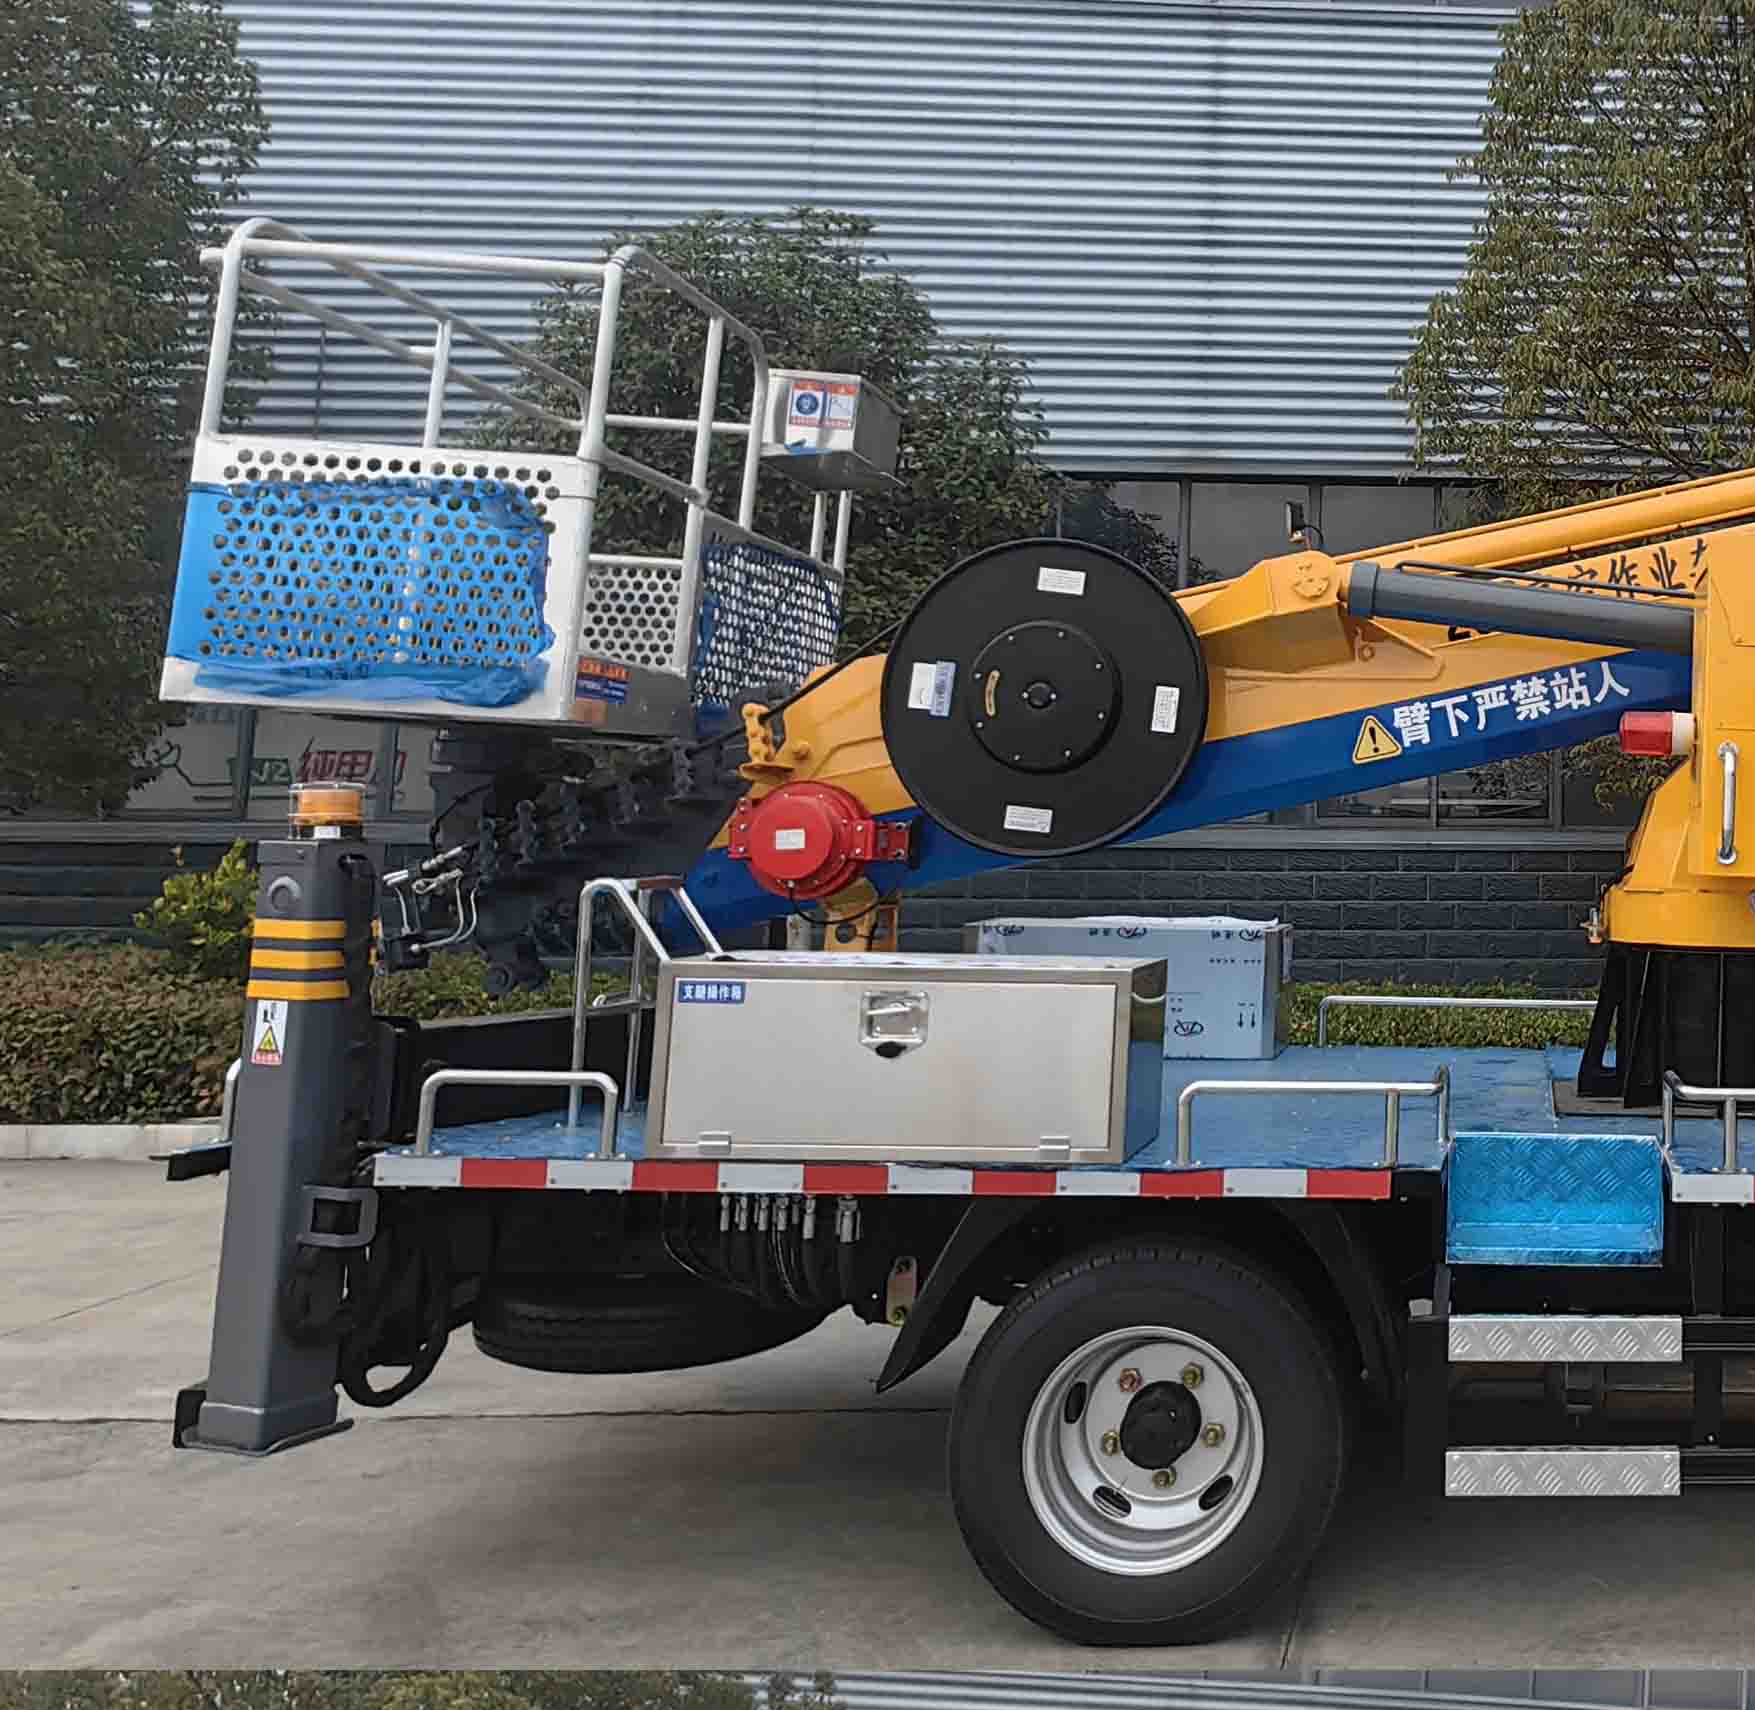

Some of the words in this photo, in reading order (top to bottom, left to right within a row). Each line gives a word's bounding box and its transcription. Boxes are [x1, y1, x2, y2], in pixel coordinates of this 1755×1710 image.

[1392, 661, 1631, 747] 臂下严禁站人
